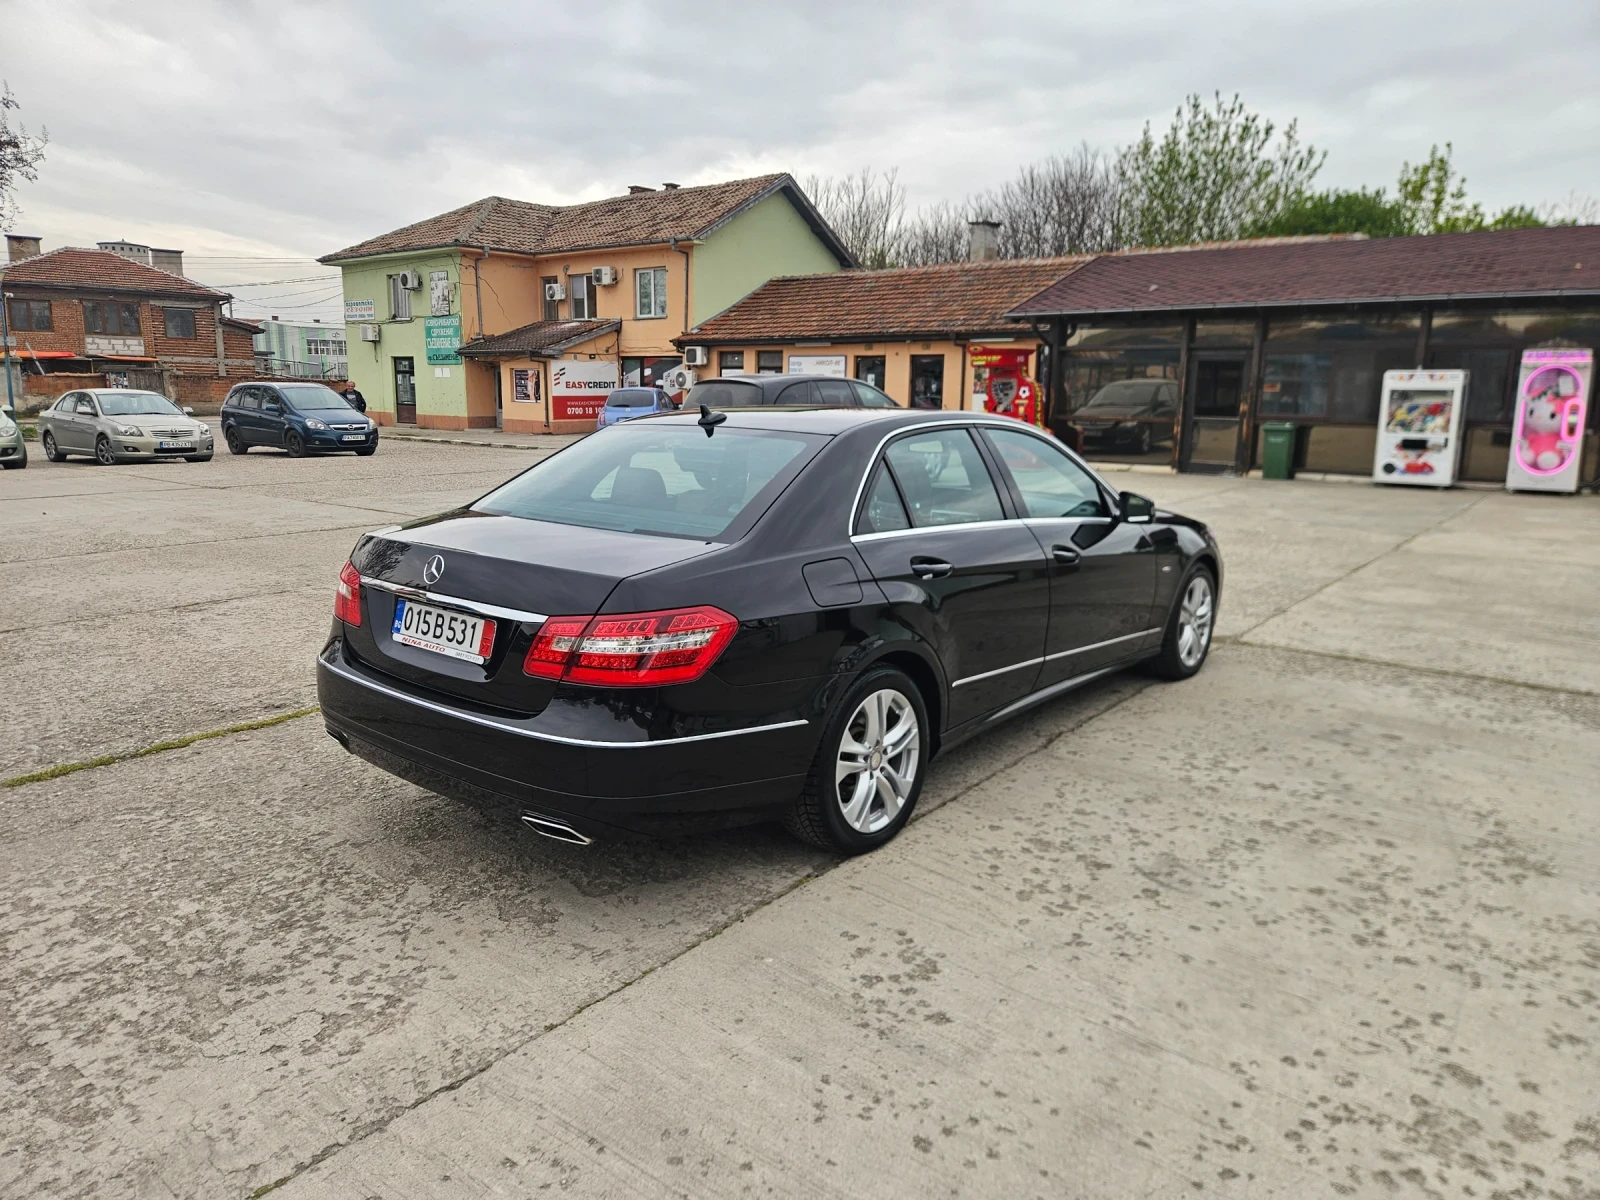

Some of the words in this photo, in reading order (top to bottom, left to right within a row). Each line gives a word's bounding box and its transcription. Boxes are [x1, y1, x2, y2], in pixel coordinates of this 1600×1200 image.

[565, 381, 616, 389] EASYCREDIT
[404, 606, 477, 648] 015B531
[402, 637, 421, 646] NINA
[424, 643, 445, 653] AUTO
